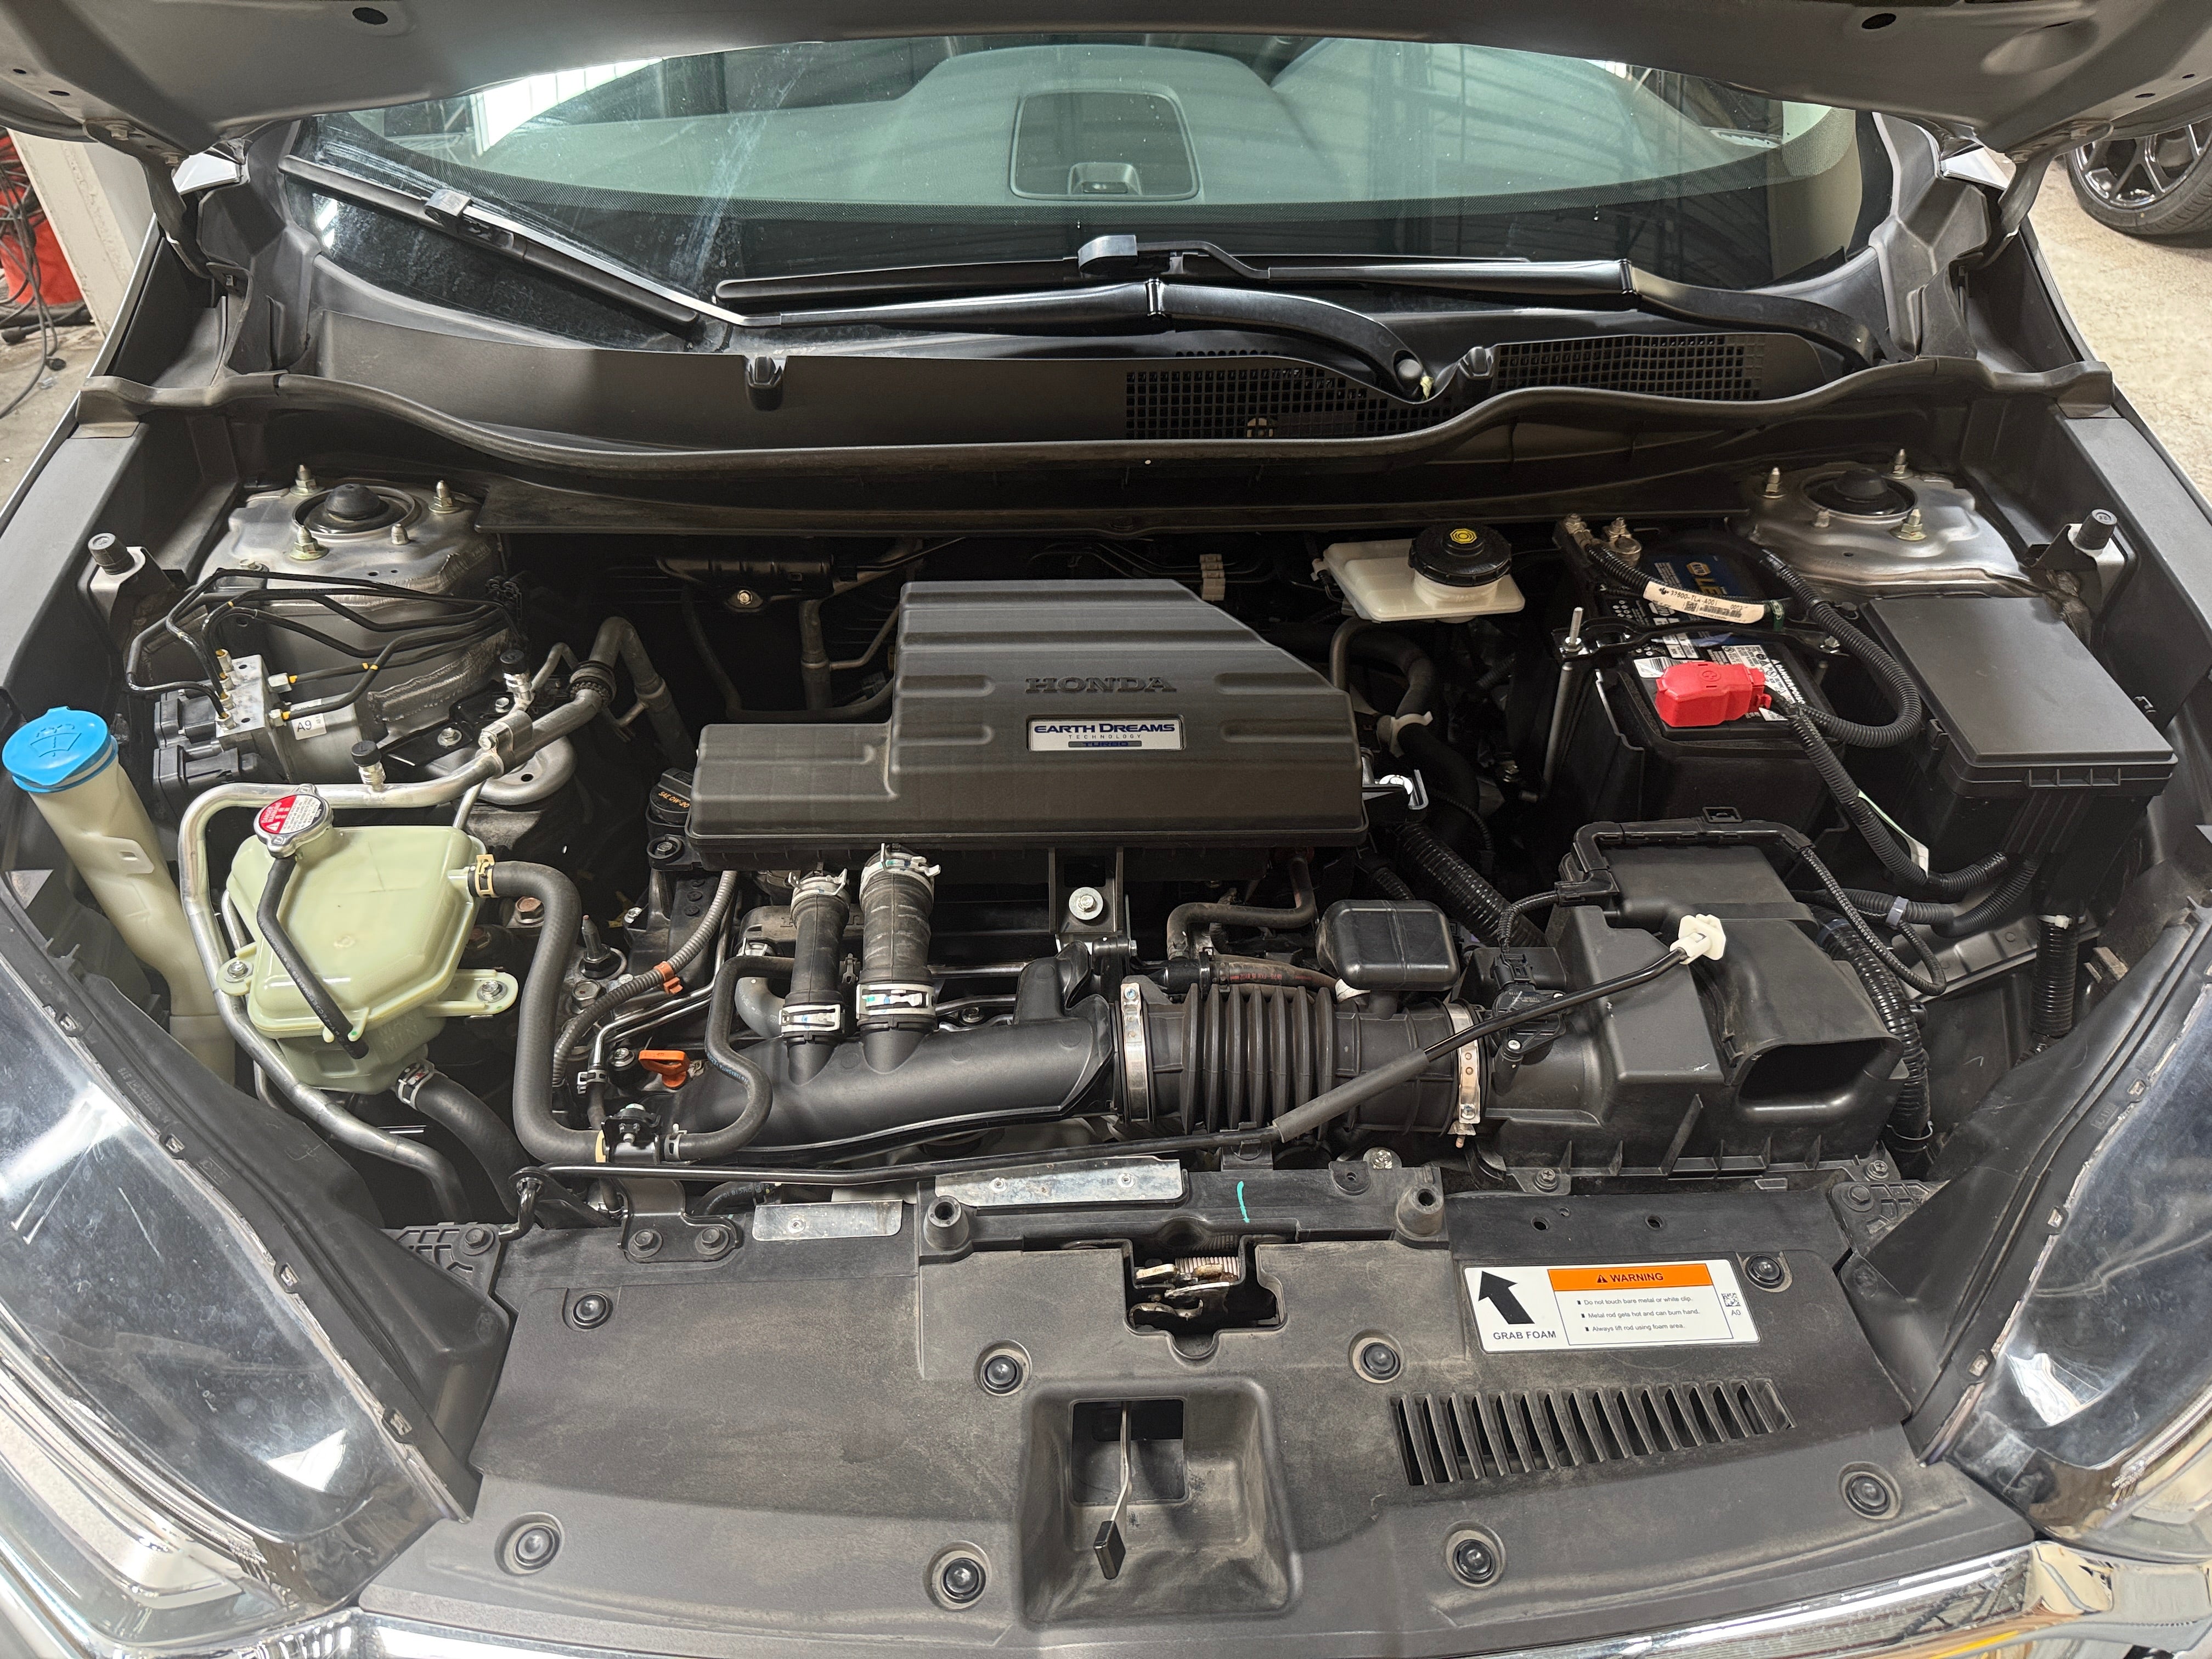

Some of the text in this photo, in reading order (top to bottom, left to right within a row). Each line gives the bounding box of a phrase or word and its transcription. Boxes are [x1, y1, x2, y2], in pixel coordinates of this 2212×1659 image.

[1025, 676, 1177, 693] HONDA
[296, 720, 312, 732] A9
[1034, 723, 1175, 733] EARTH DREAMS
[658, 791, 672, 799] SAE
[383, 1024, 419, 1052] MIN
[1610, 1272, 1664, 1284] WARNING
[1493, 1330, 1556, 1340] GRAB FOAM
